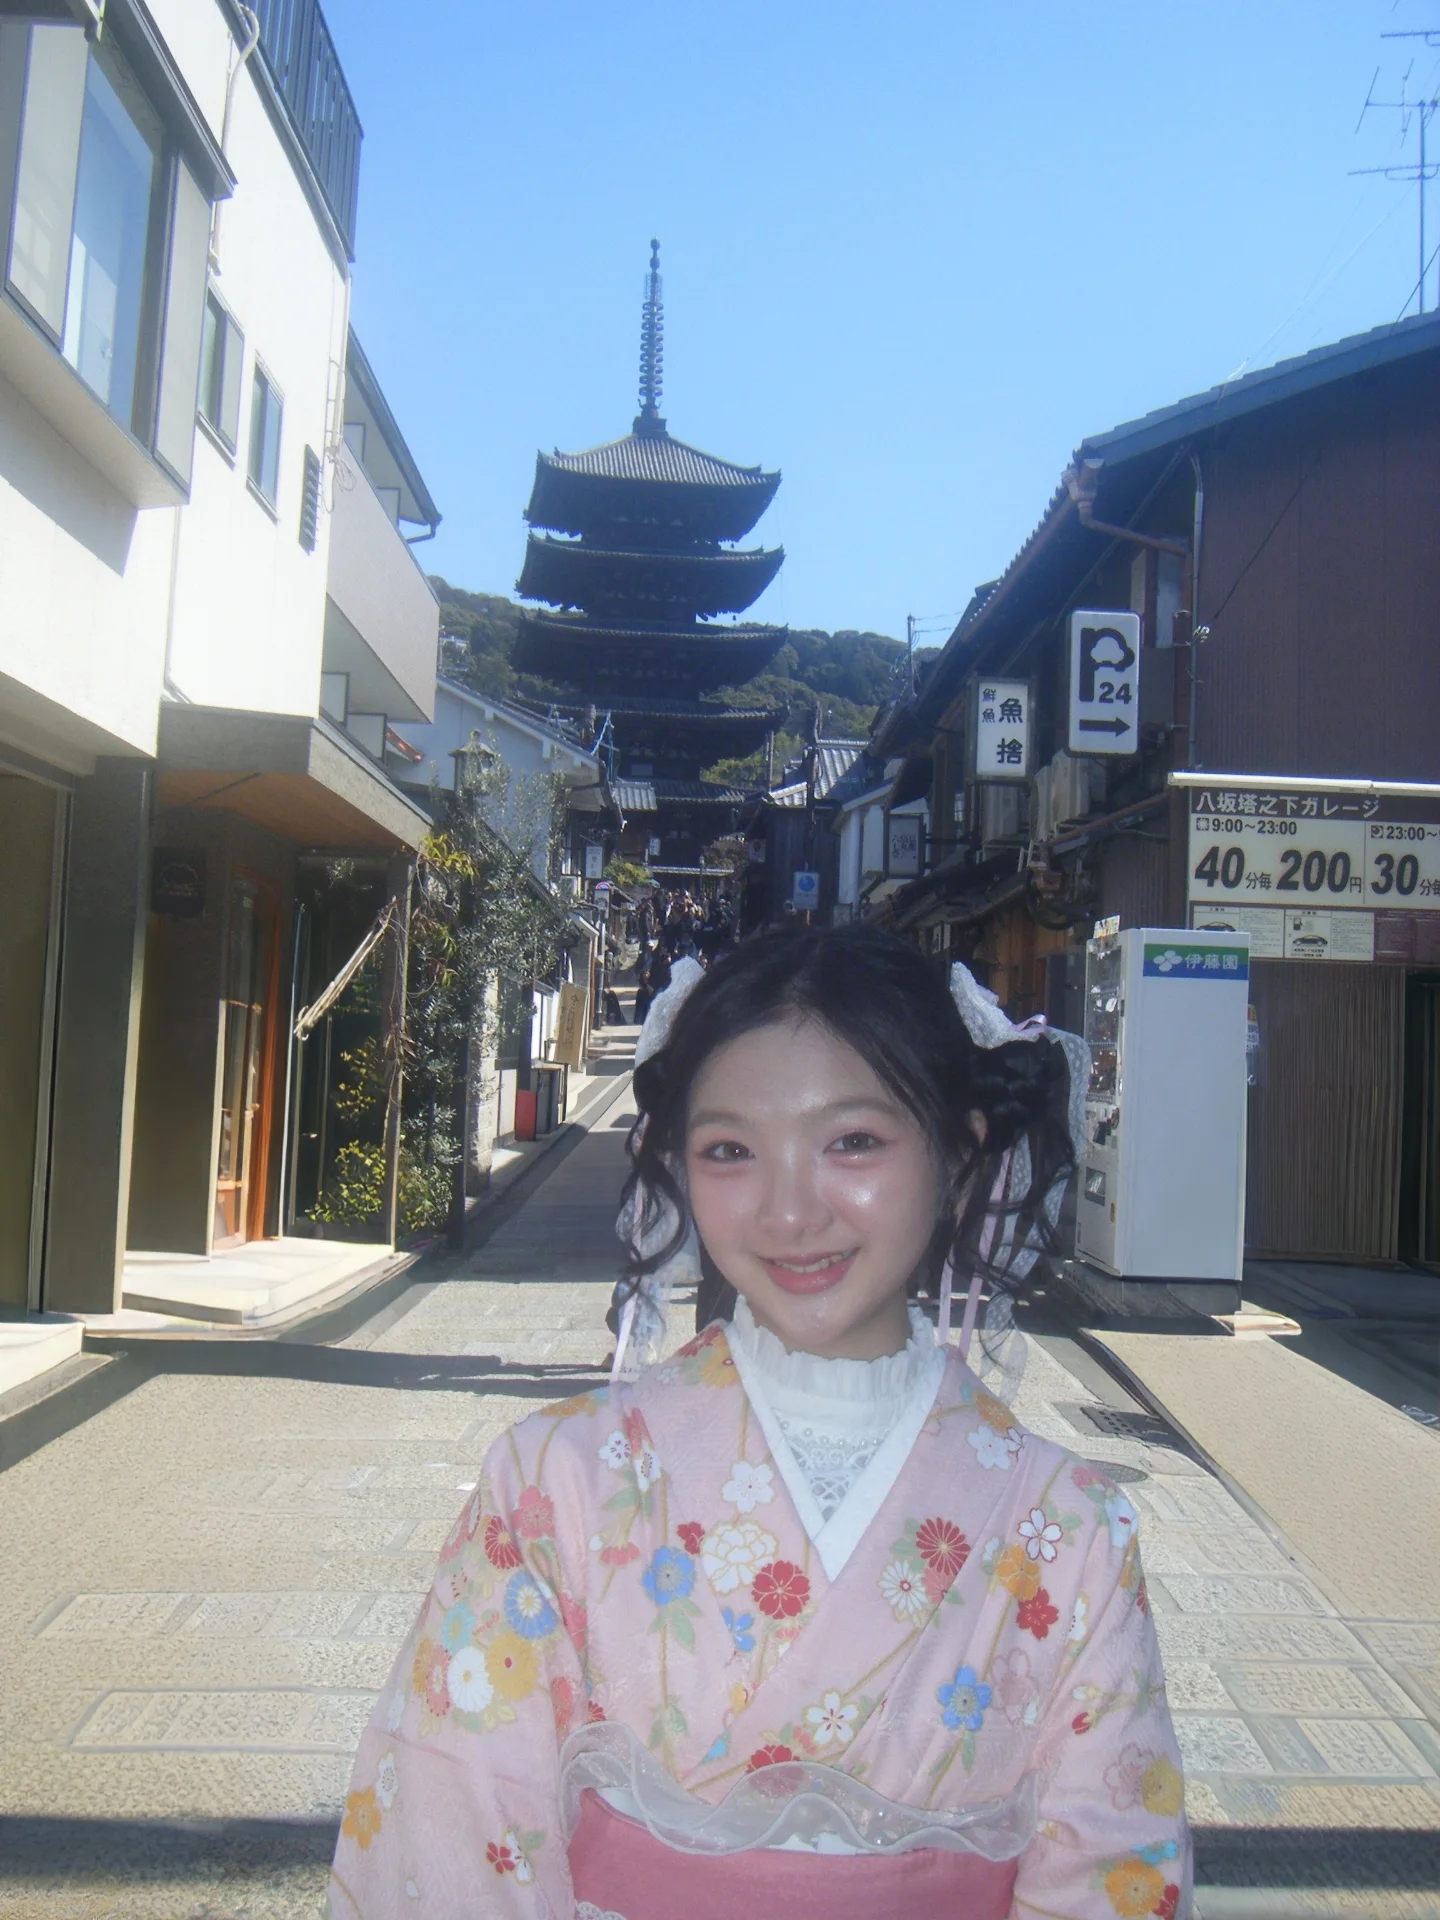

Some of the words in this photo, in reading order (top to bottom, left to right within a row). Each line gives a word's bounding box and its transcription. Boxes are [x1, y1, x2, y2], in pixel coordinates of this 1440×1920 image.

[981, 688, 997, 723] 鮮魚
[1099, 681, 1132, 705] 24
[996, 697, 1023, 765] 魚捨
[1196, 791, 1380, 818] 八坂塔之下ガレージ
[1386, 825, 1440, 840] 23:00～
[1185, 953, 1238, 970] 伊藤園
